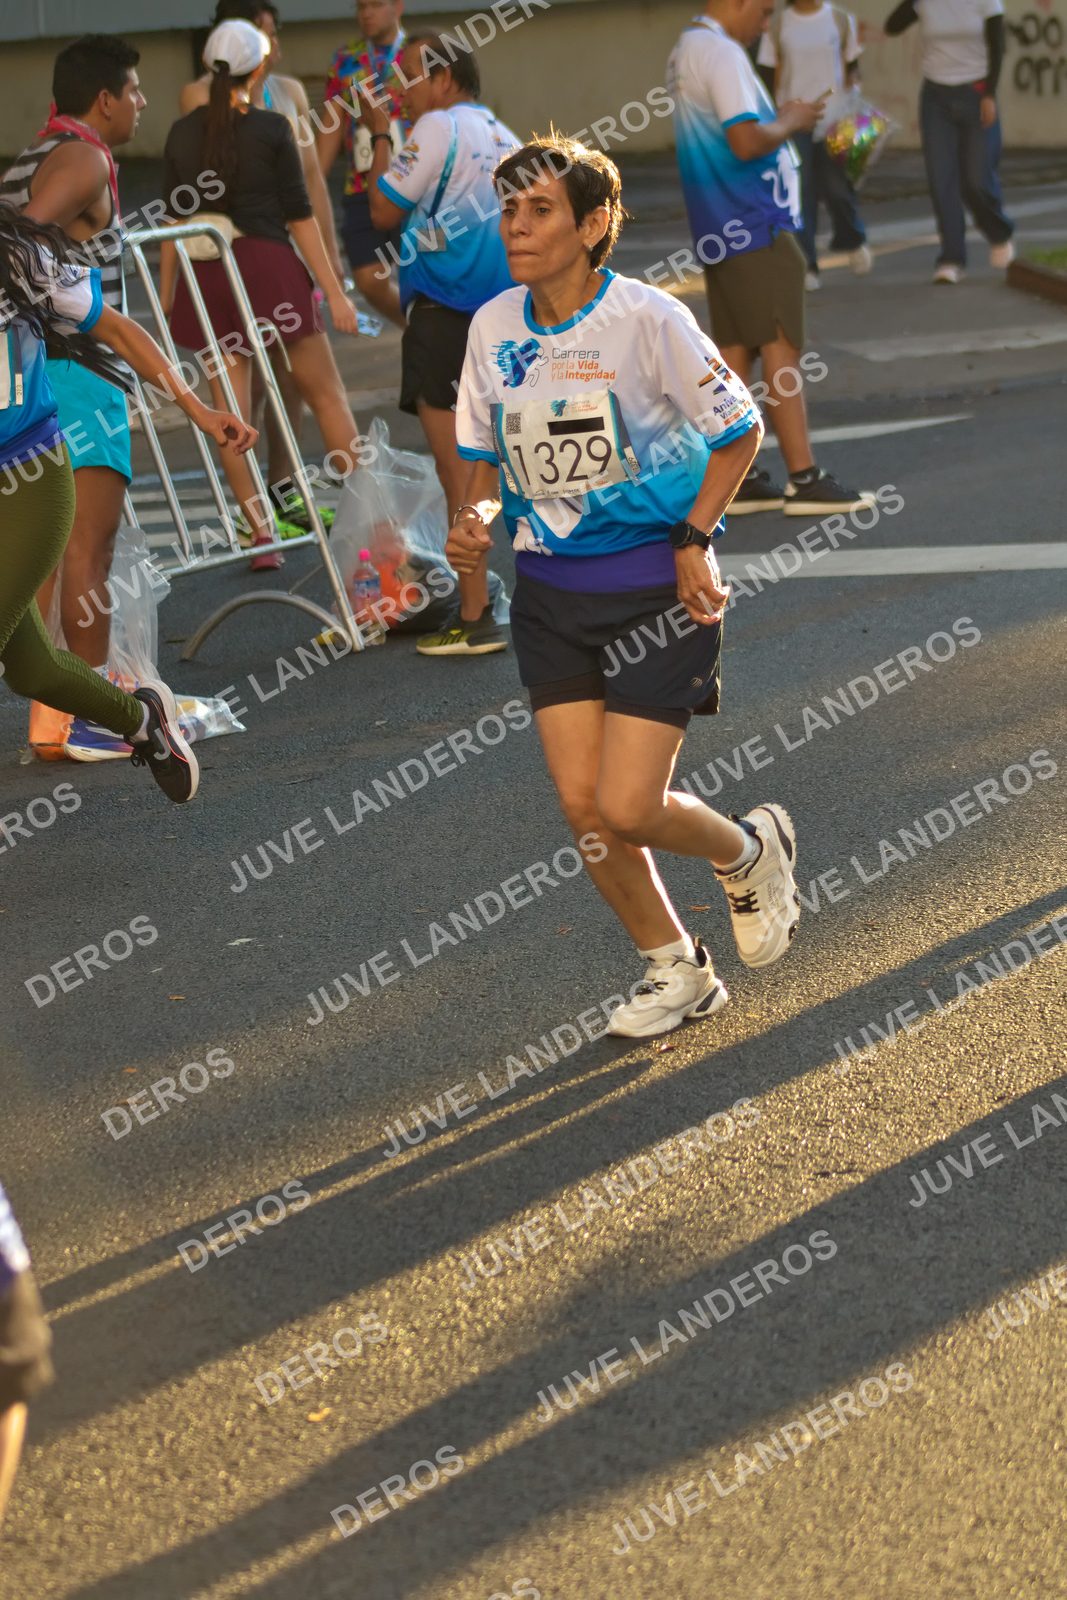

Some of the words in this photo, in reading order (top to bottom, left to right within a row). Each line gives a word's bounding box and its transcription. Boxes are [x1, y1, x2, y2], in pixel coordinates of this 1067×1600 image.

[552, 347, 600, 360] Carrera
[578, 360, 599, 370] Vida
[565, 369, 616, 382] Integridad
[512, 435, 612, 485] 1329
